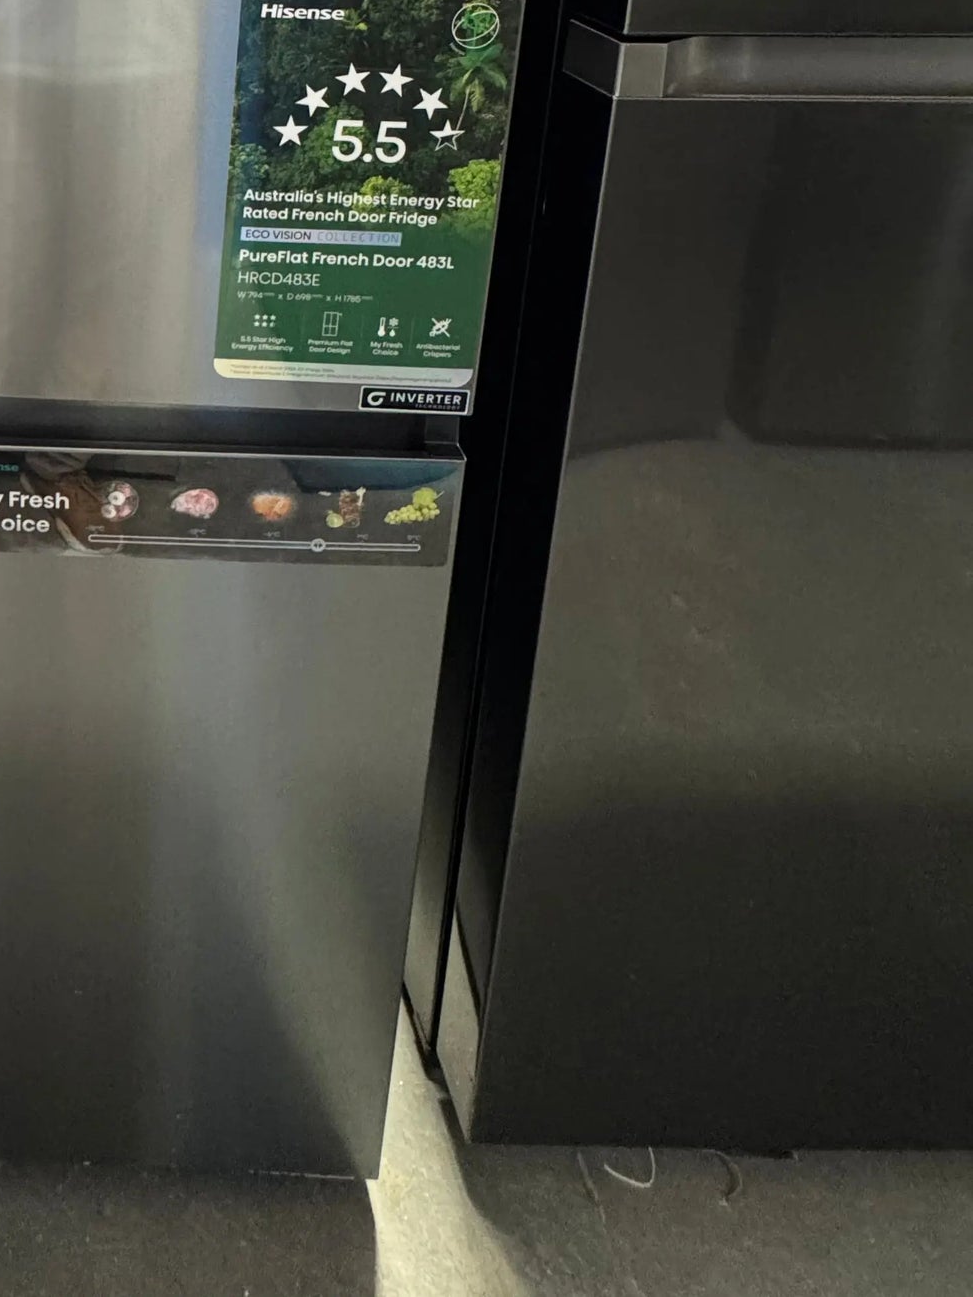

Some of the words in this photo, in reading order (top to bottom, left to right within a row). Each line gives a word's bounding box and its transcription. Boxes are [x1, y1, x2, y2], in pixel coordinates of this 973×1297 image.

[260, 3, 345, 21] Hisense
[331, 119, 408, 164] 5.5
[243, 188, 324, 203] Australia's
[327, 191, 386, 207] Highest
[390, 194, 444, 210] Energy
[447, 196, 480, 208] Star
[243, 206, 288, 220] Rated
[291, 208, 344, 222] French
[348, 210, 386, 223] Door
[389, 212, 438, 227] Fridge
[245, 229, 270, 239] ECO
[273, 230, 312, 241] VISION
[317, 232, 399, 242] COLLECTION
[239, 249, 308, 263] PureFlat
[312, 252, 369, 266] French
[372, 253, 414, 268] Door
[416, 256, 454, 269] 483L
[237, 271, 321, 286] HRCD483E
[390, 392, 462, 405] INVERTER
[8, 490, 70, 510] Fresh
